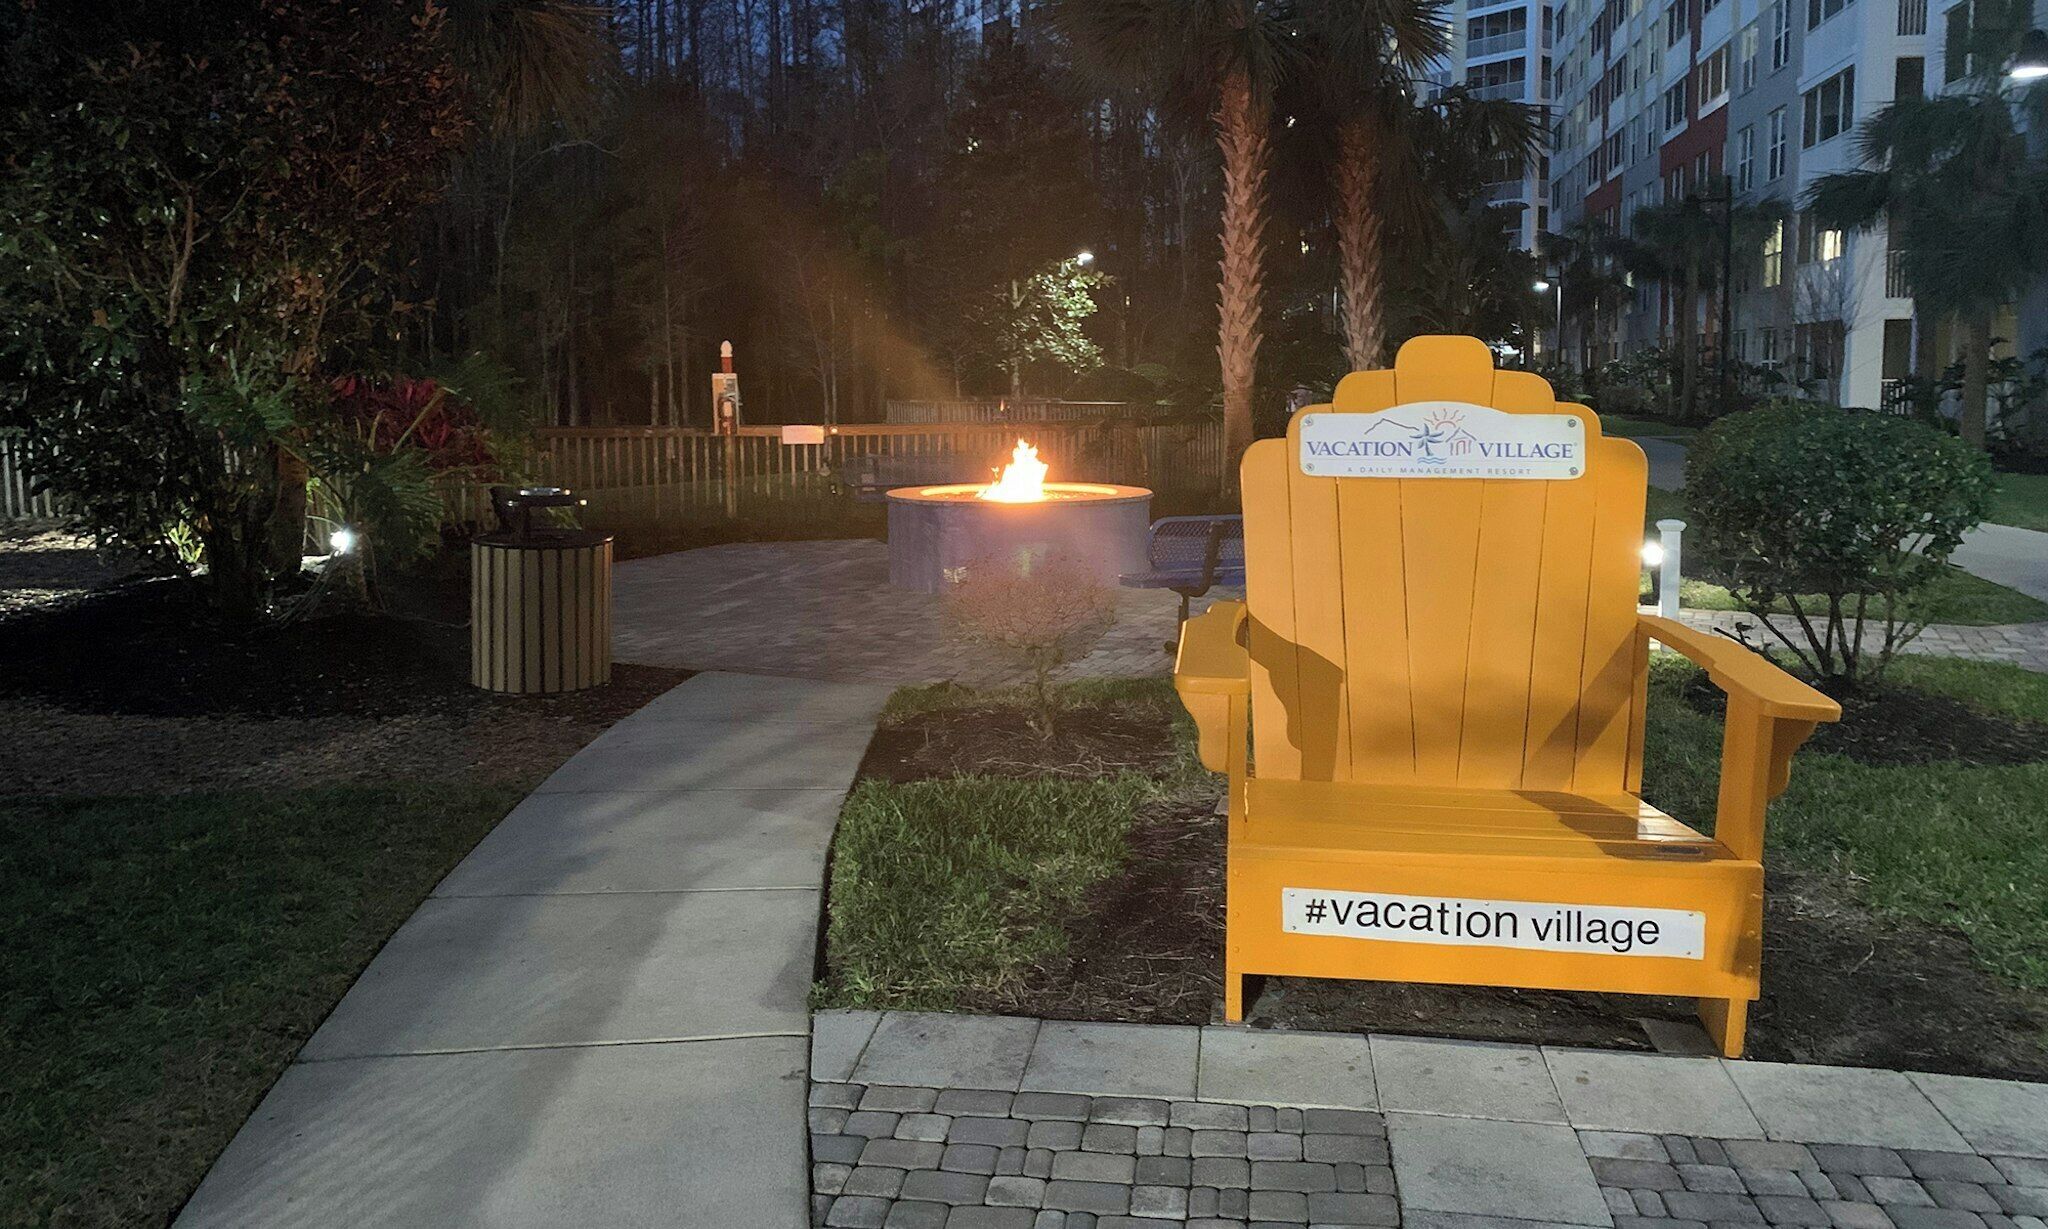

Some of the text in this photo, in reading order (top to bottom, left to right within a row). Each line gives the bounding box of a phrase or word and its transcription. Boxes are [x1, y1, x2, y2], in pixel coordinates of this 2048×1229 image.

[1306, 441, 1574, 459] VACATION VILLAGE
[1346, 466, 1354, 474] A
[1359, 466, 1393, 474] DAILY
[1400, 467, 1480, 475] MANAGEMENT
[1305, 898, 1660, 952] #vacation village
